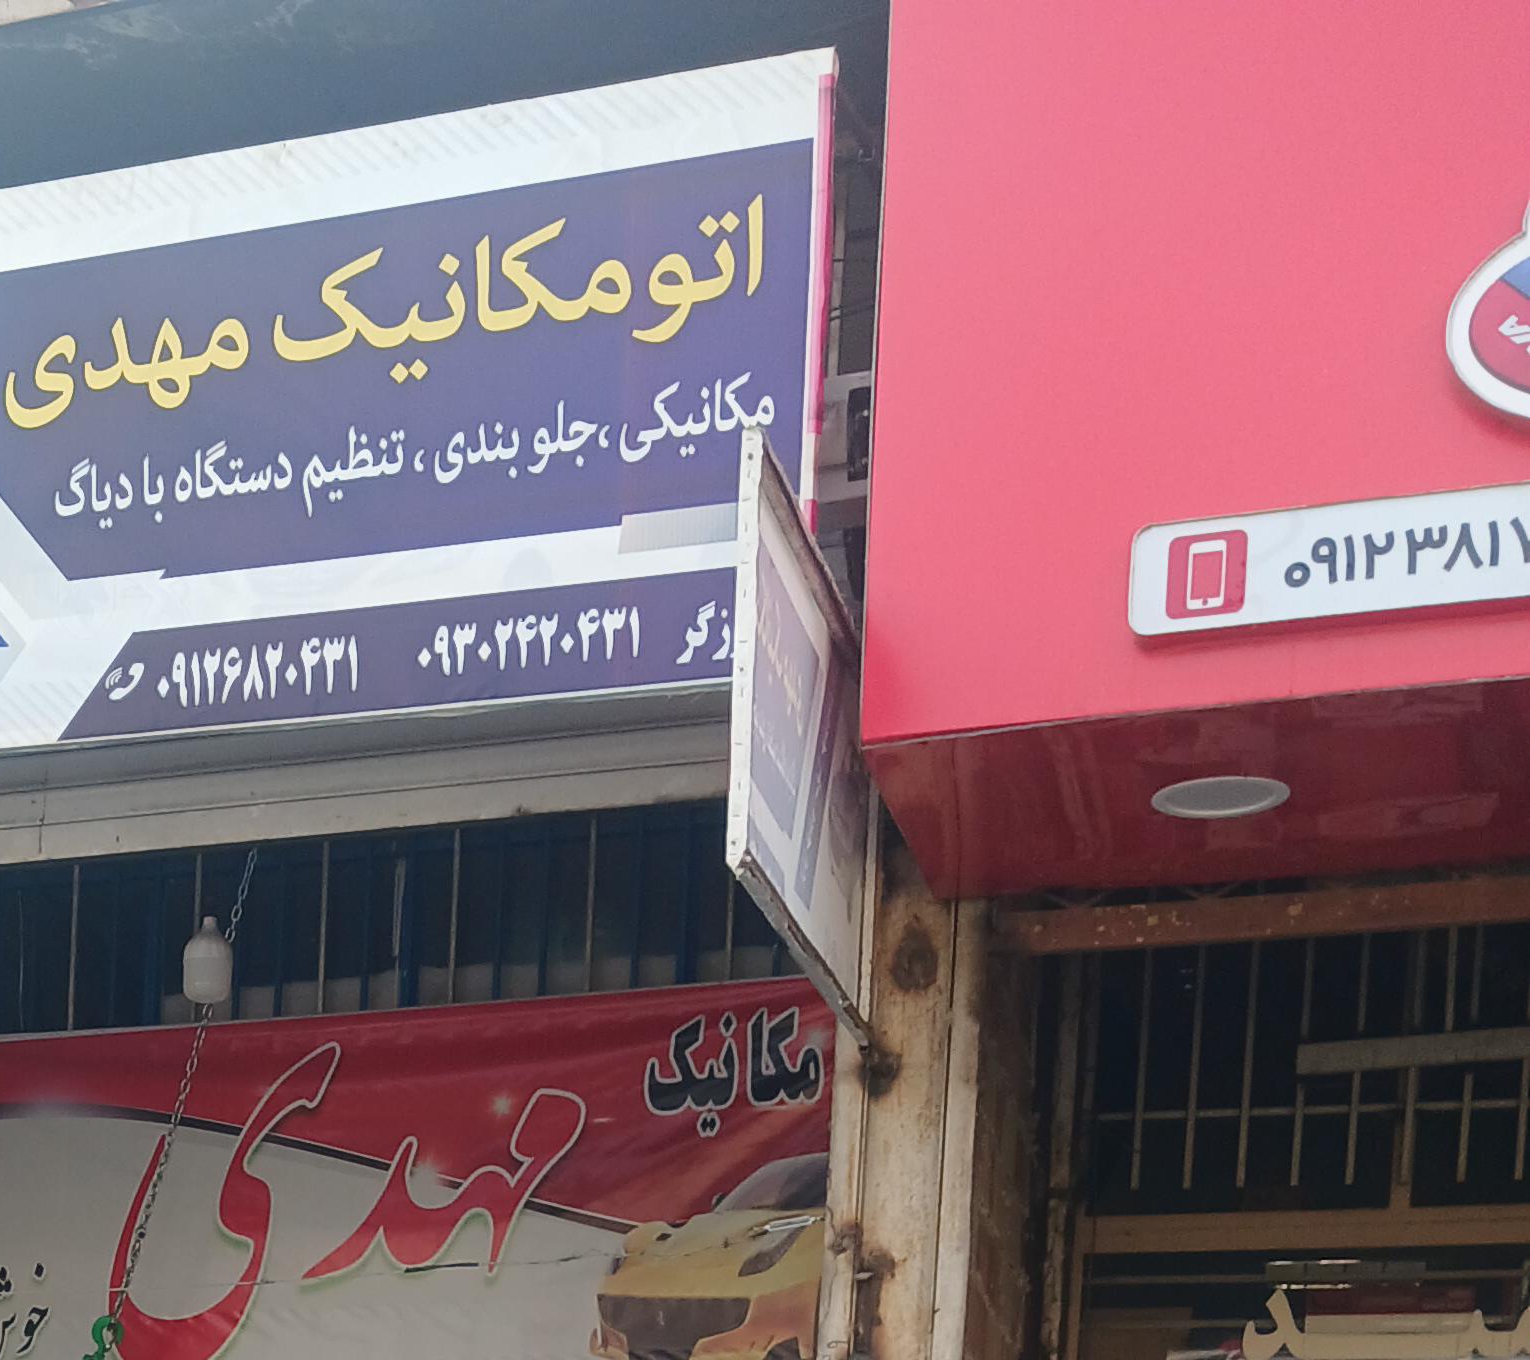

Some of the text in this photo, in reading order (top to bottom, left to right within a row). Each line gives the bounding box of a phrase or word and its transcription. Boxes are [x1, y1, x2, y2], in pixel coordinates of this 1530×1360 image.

[4, 315, 250, 429] مهدی
[620, 371, 775, 462] مکانیکی
[55, 458, 133, 529] دیاگ
[142, 454, 165, 523] با
[174, 441, 293, 502] دستگاه
[302, 426, 405, 518] تنظیم
[157, 634, 358, 708] ۰۹۱۲۶۸۲۰۴۳۱
[417, 606, 641, 676] ۰۹۳۰۲۴۲۰۴۳۱
[645, 1007, 823, 1137] مکانیک
